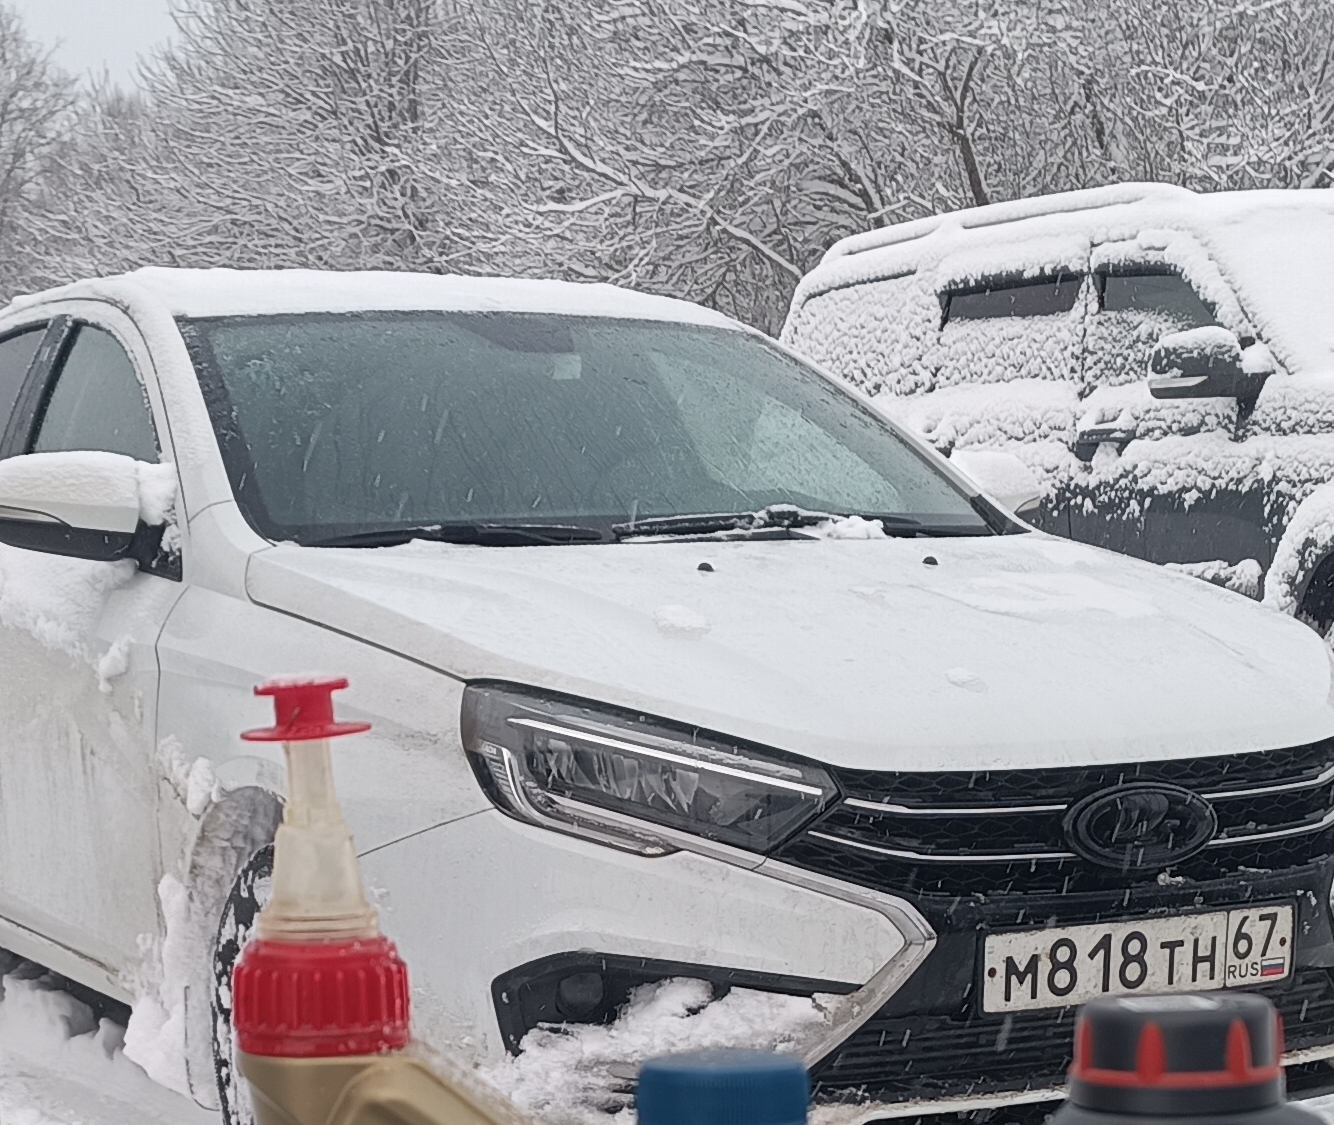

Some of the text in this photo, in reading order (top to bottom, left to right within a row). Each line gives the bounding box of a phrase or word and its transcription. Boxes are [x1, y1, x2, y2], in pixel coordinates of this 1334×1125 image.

[1232, 912, 1278, 959] 67
[1004, 930, 1217, 1003] М818ТН
[1227, 961, 1259, 980] RUS
